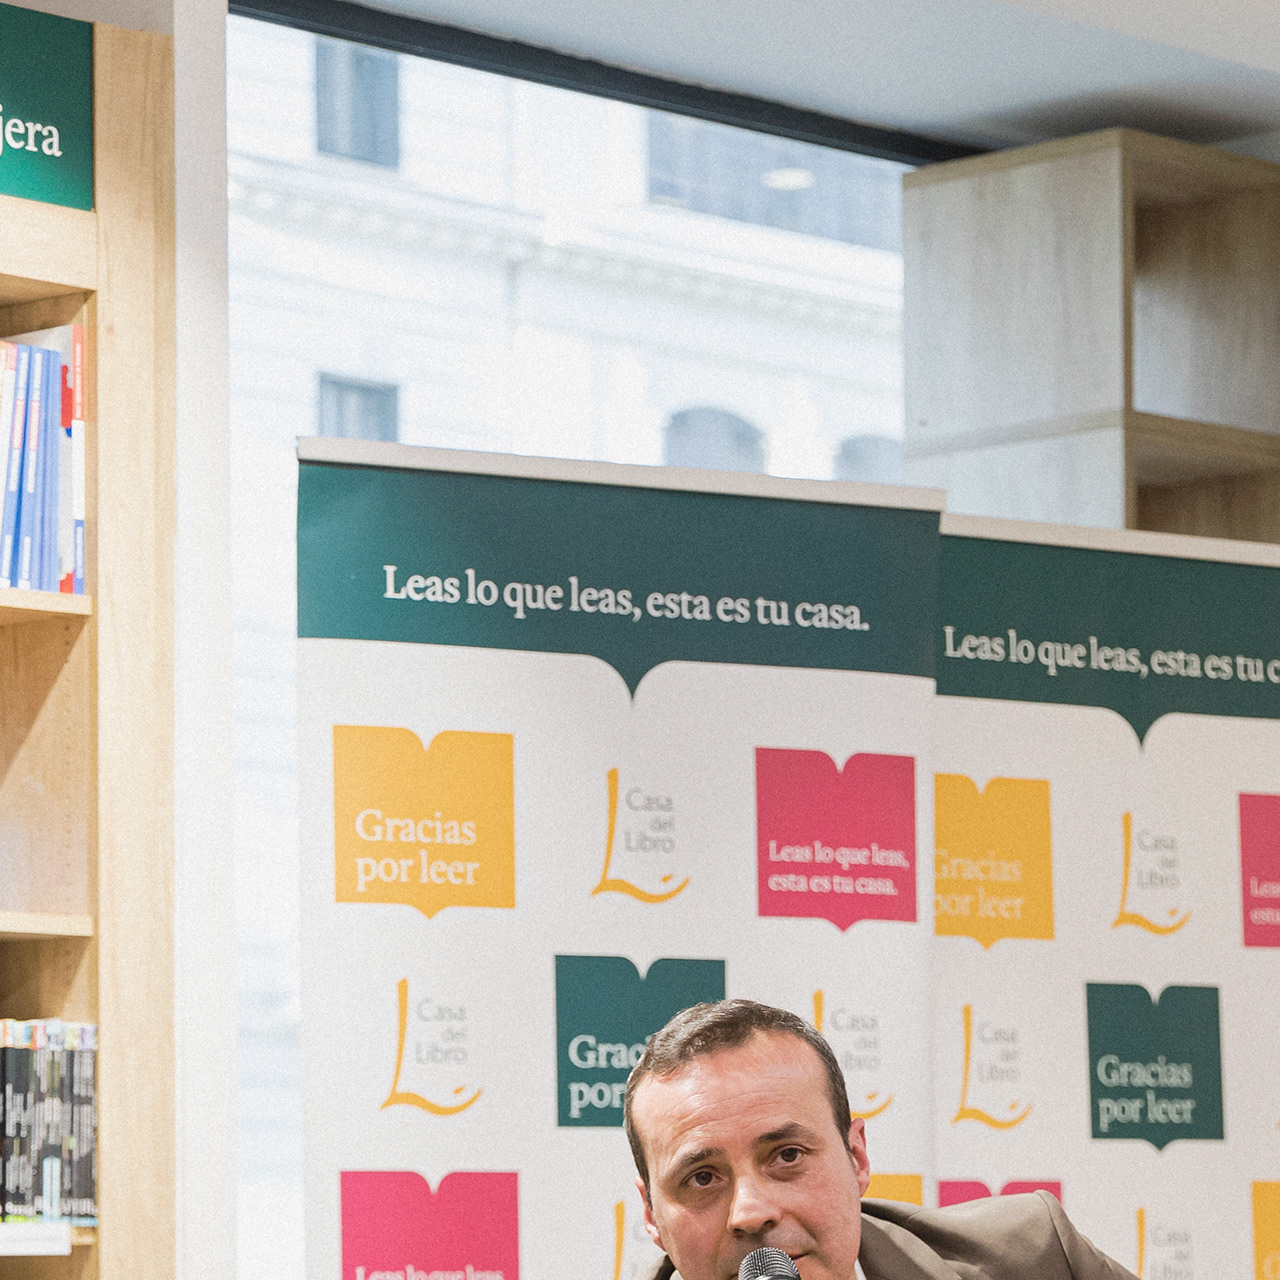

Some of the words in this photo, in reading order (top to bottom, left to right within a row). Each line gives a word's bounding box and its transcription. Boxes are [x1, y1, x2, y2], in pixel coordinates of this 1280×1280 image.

[383, 565, 461, 604] Leas
[465, 568, 499, 606] lo
[503, 582, 564, 619] que
[568, 575, 642, 623] leas,
[646, 591, 713, 621] esta
[716, 596, 751, 623] es
[755, 596, 791, 626] tu
[794, 602, 870, 631] casa.
[943, 625, 1006, 662] Leas
[1007, 628, 1035, 664] lo
[1038, 641, 1087, 676] que
[1088, 636, 1149, 679] leas,
[1150, 650, 1203, 677] esta
[1204, 655, 1233, 680] es
[1235, 655, 1265, 682] tu
[625, 787, 674, 813] Casa
[355, 809, 478, 846] Gracias
[625, 832, 675, 855] Libro
[769, 840, 813, 862] Leas
[814, 840, 835, 863] lo
[835, 847, 870, 870] que
[357, 855, 413, 892] por
[420, 851, 479, 887] leer
[768, 874, 809, 892] esta
[809, 875, 832, 893] es
[832, 875, 855, 893] tu
[977, 885, 1025, 919] leer
[417, 998, 467, 1024] Casa
[831, 1008, 880, 1033] Casa
[416, 1041, 468, 1065] Libro
[840, 1050, 881, 1072] ibro
[1096, 1054, 1193, 1088] Gracias
[568, 1082, 627, 1118] por
[1099, 1096, 1143, 1131] por
[1146, 1092, 1195, 1125] leer
